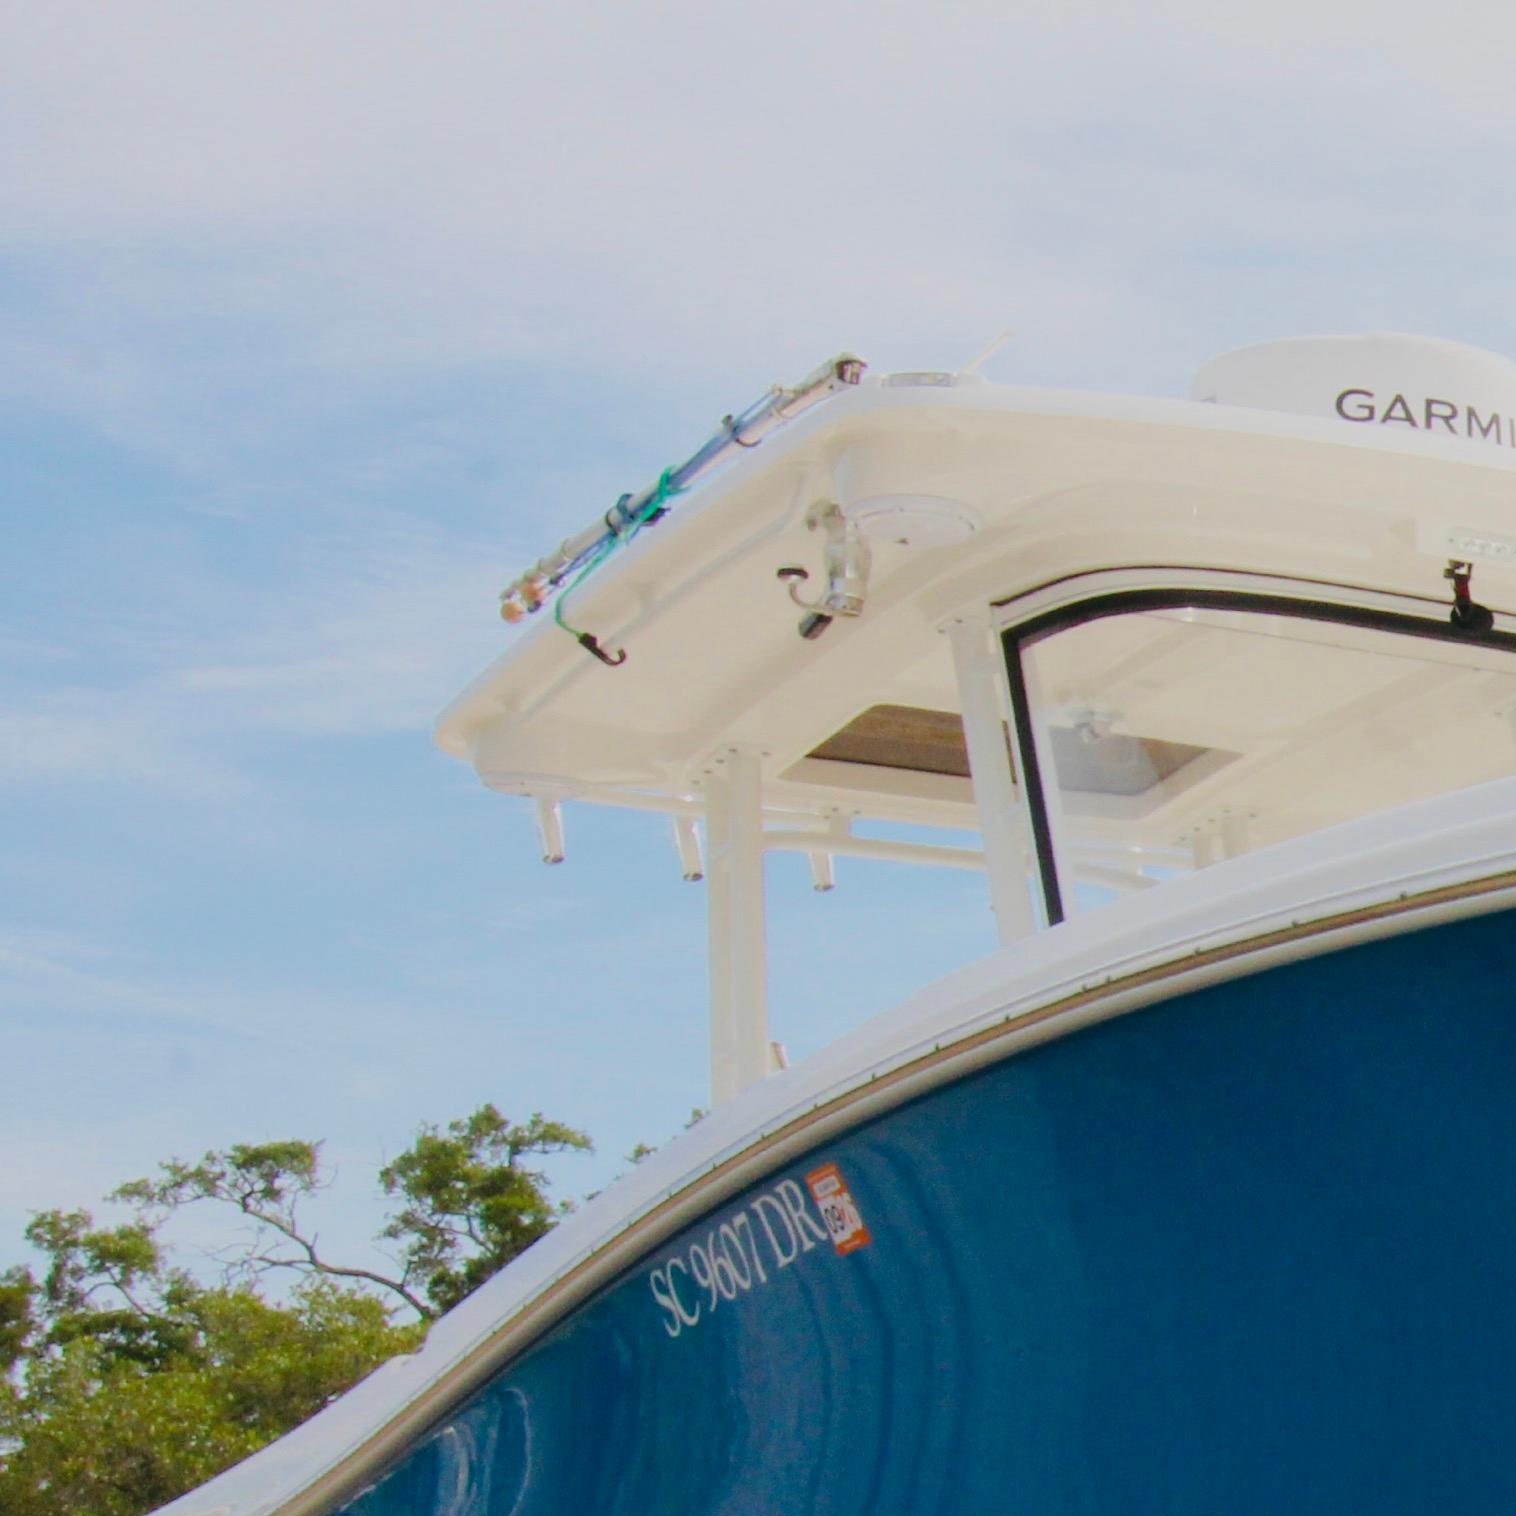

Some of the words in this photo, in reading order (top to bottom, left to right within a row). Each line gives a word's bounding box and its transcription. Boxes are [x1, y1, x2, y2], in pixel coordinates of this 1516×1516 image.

[650, 1257, 699, 1338] SC
[690, 1211, 767, 1312] 9607
[751, 1179, 829, 1268] DR
